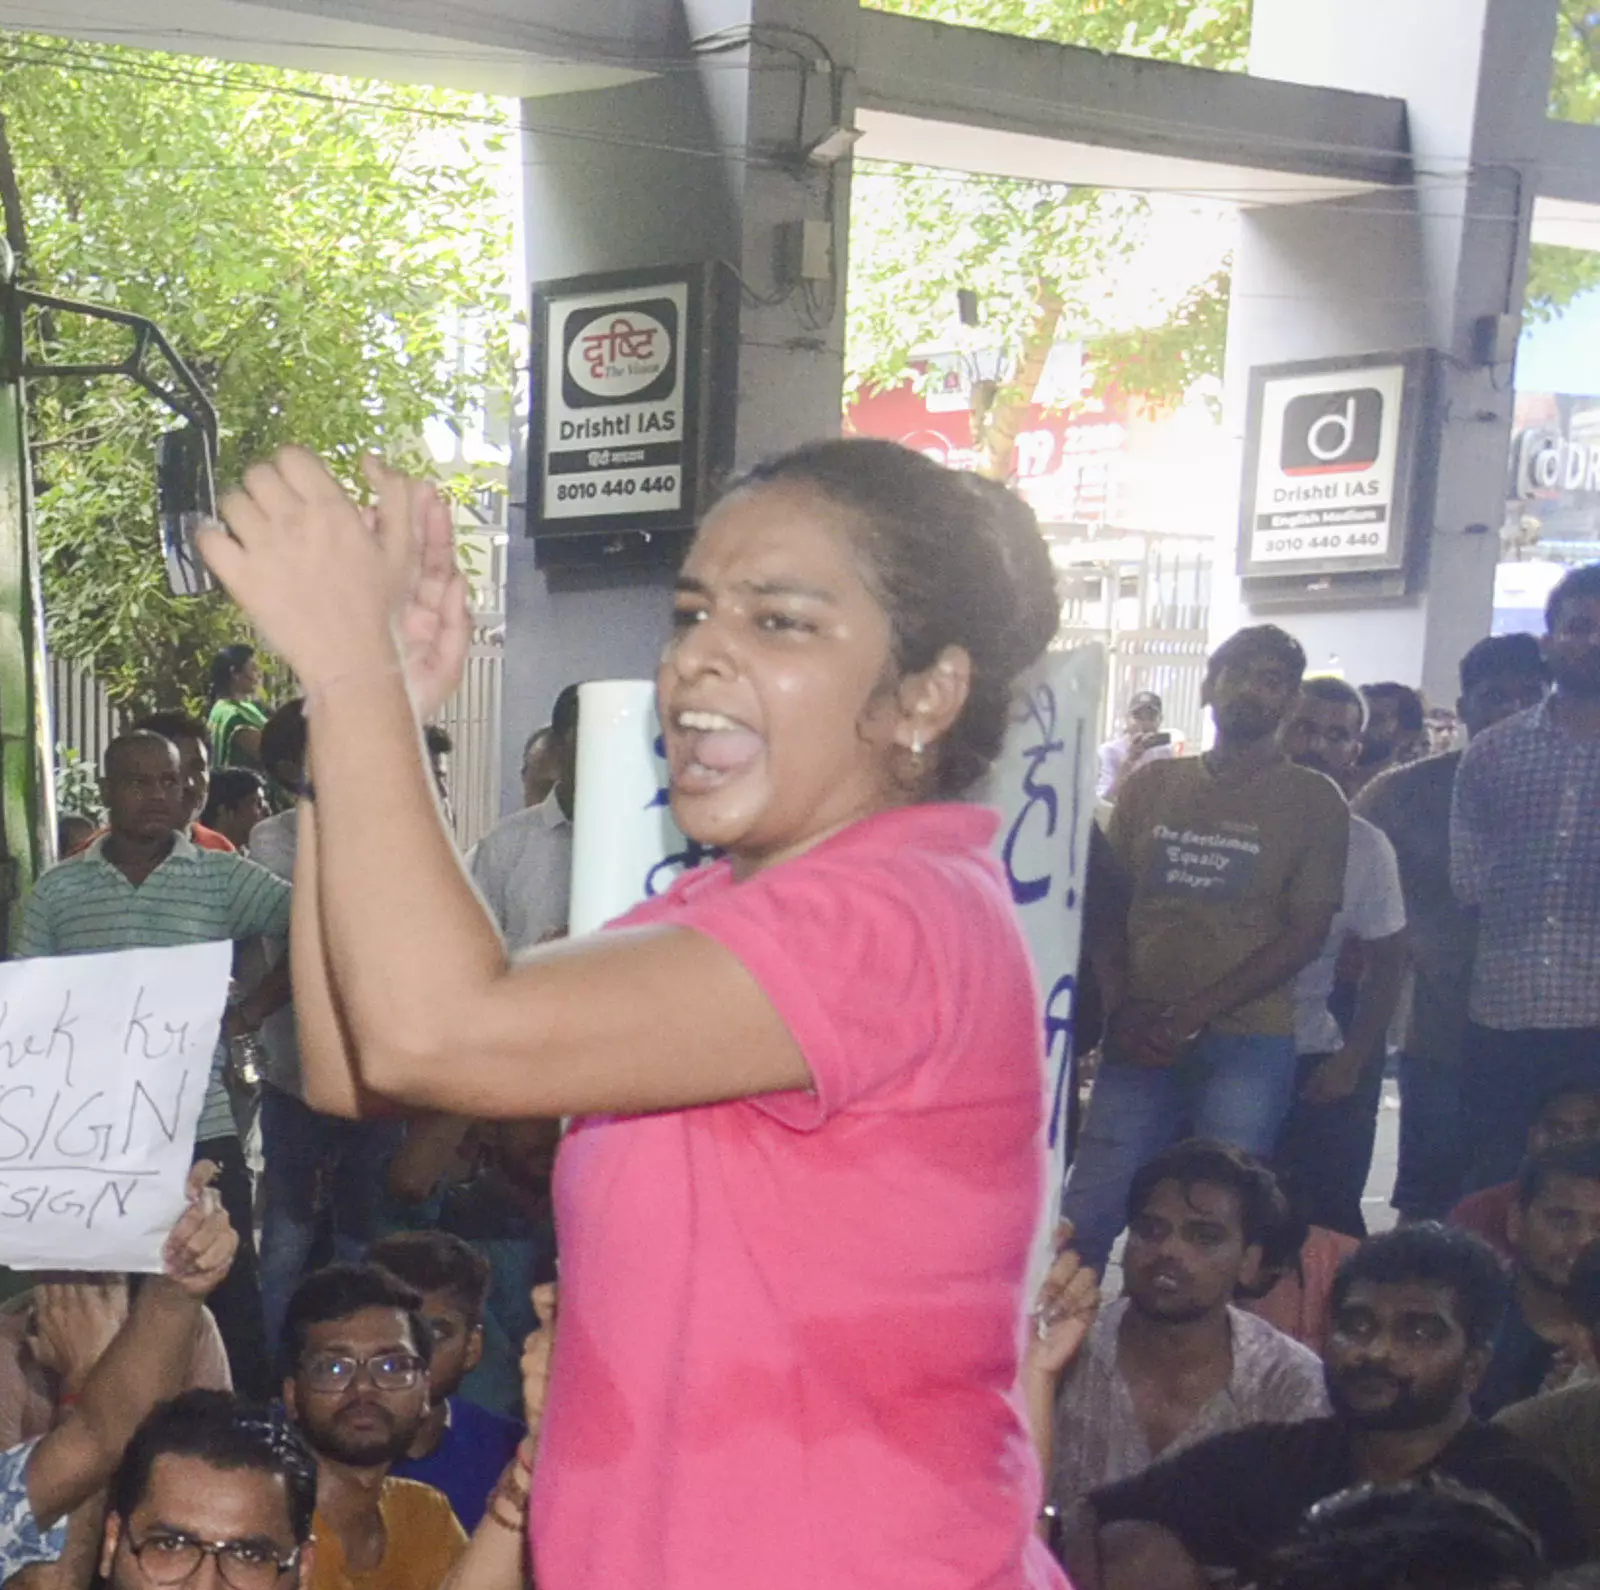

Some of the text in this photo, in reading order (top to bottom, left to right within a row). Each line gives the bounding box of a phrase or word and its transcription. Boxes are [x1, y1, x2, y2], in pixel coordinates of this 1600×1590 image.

[582, 319, 658, 379] दृष्टि
[560, 410, 676, 441] Drishti IAS
[557, 475, 676, 501] 8010 440 440
[1274, 479, 1380, 503] Drishti IAS
[1271, 514, 1321, 528] English
[1307, 535, 1342, 549] 440
[1346, 531, 1380, 547] 440
